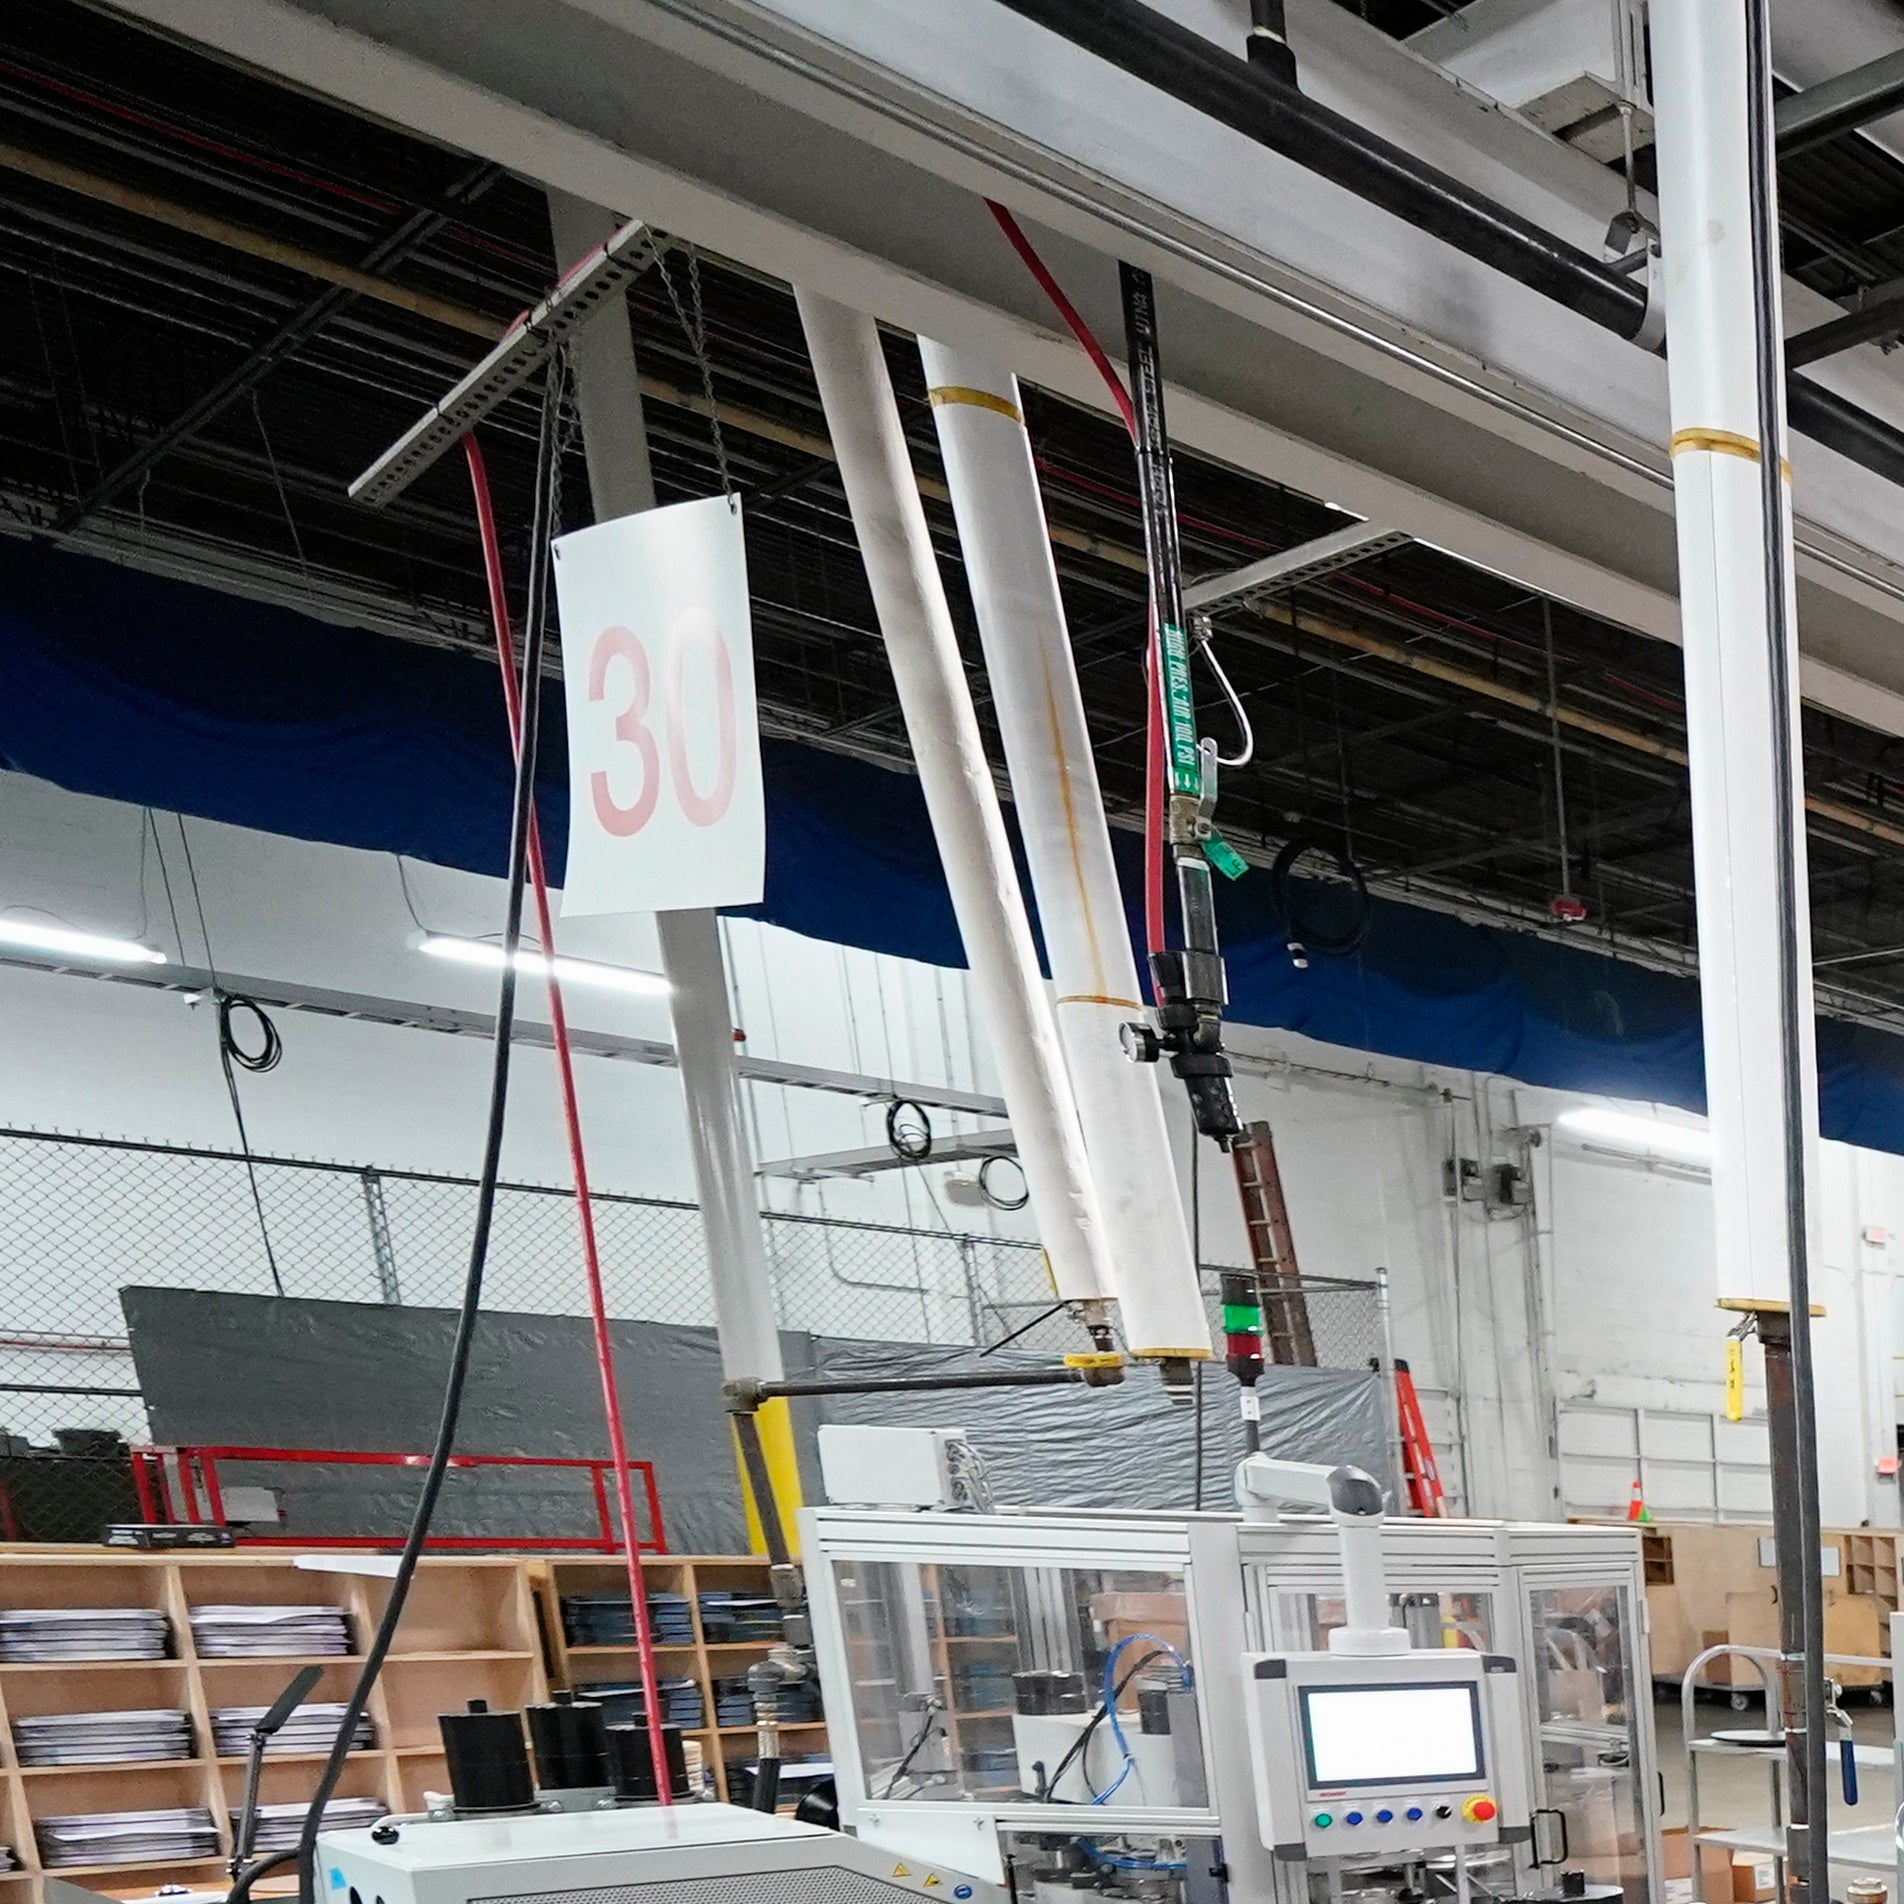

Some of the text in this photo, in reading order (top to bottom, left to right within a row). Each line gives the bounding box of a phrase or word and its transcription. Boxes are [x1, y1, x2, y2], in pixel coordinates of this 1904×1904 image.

[1172, 696, 1191, 718] AIR
[588, 607, 738, 838] 30
[1174, 721, 1193, 742] 100
[1177, 743, 1195, 766] PSI
